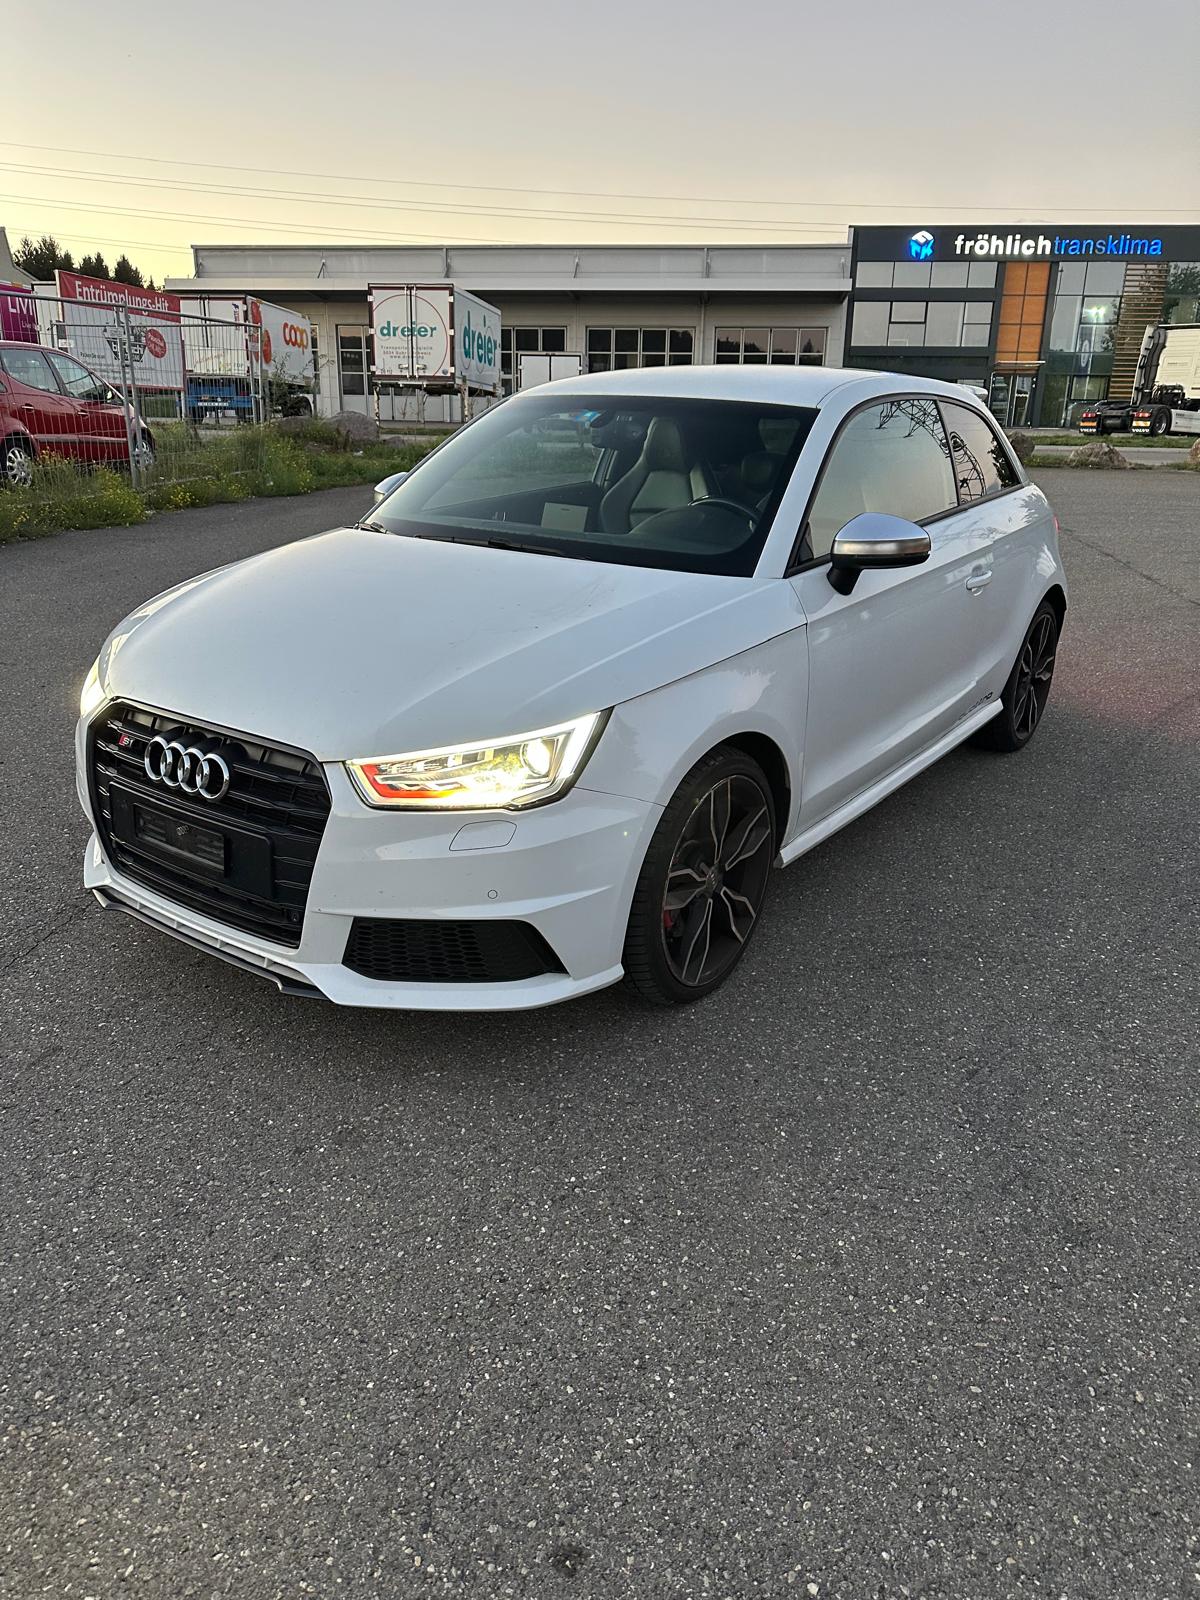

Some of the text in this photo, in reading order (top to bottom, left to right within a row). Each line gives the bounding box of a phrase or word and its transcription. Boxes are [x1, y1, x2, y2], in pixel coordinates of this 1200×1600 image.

[954, 234, 1162, 256] fröhlich transklima
[75, 280, 169, 315] Entrümplungs-Hit
[283, 322, 309, 355] coop
[379, 321, 437, 337] dreier
[463, 310, 497, 367] dreier
